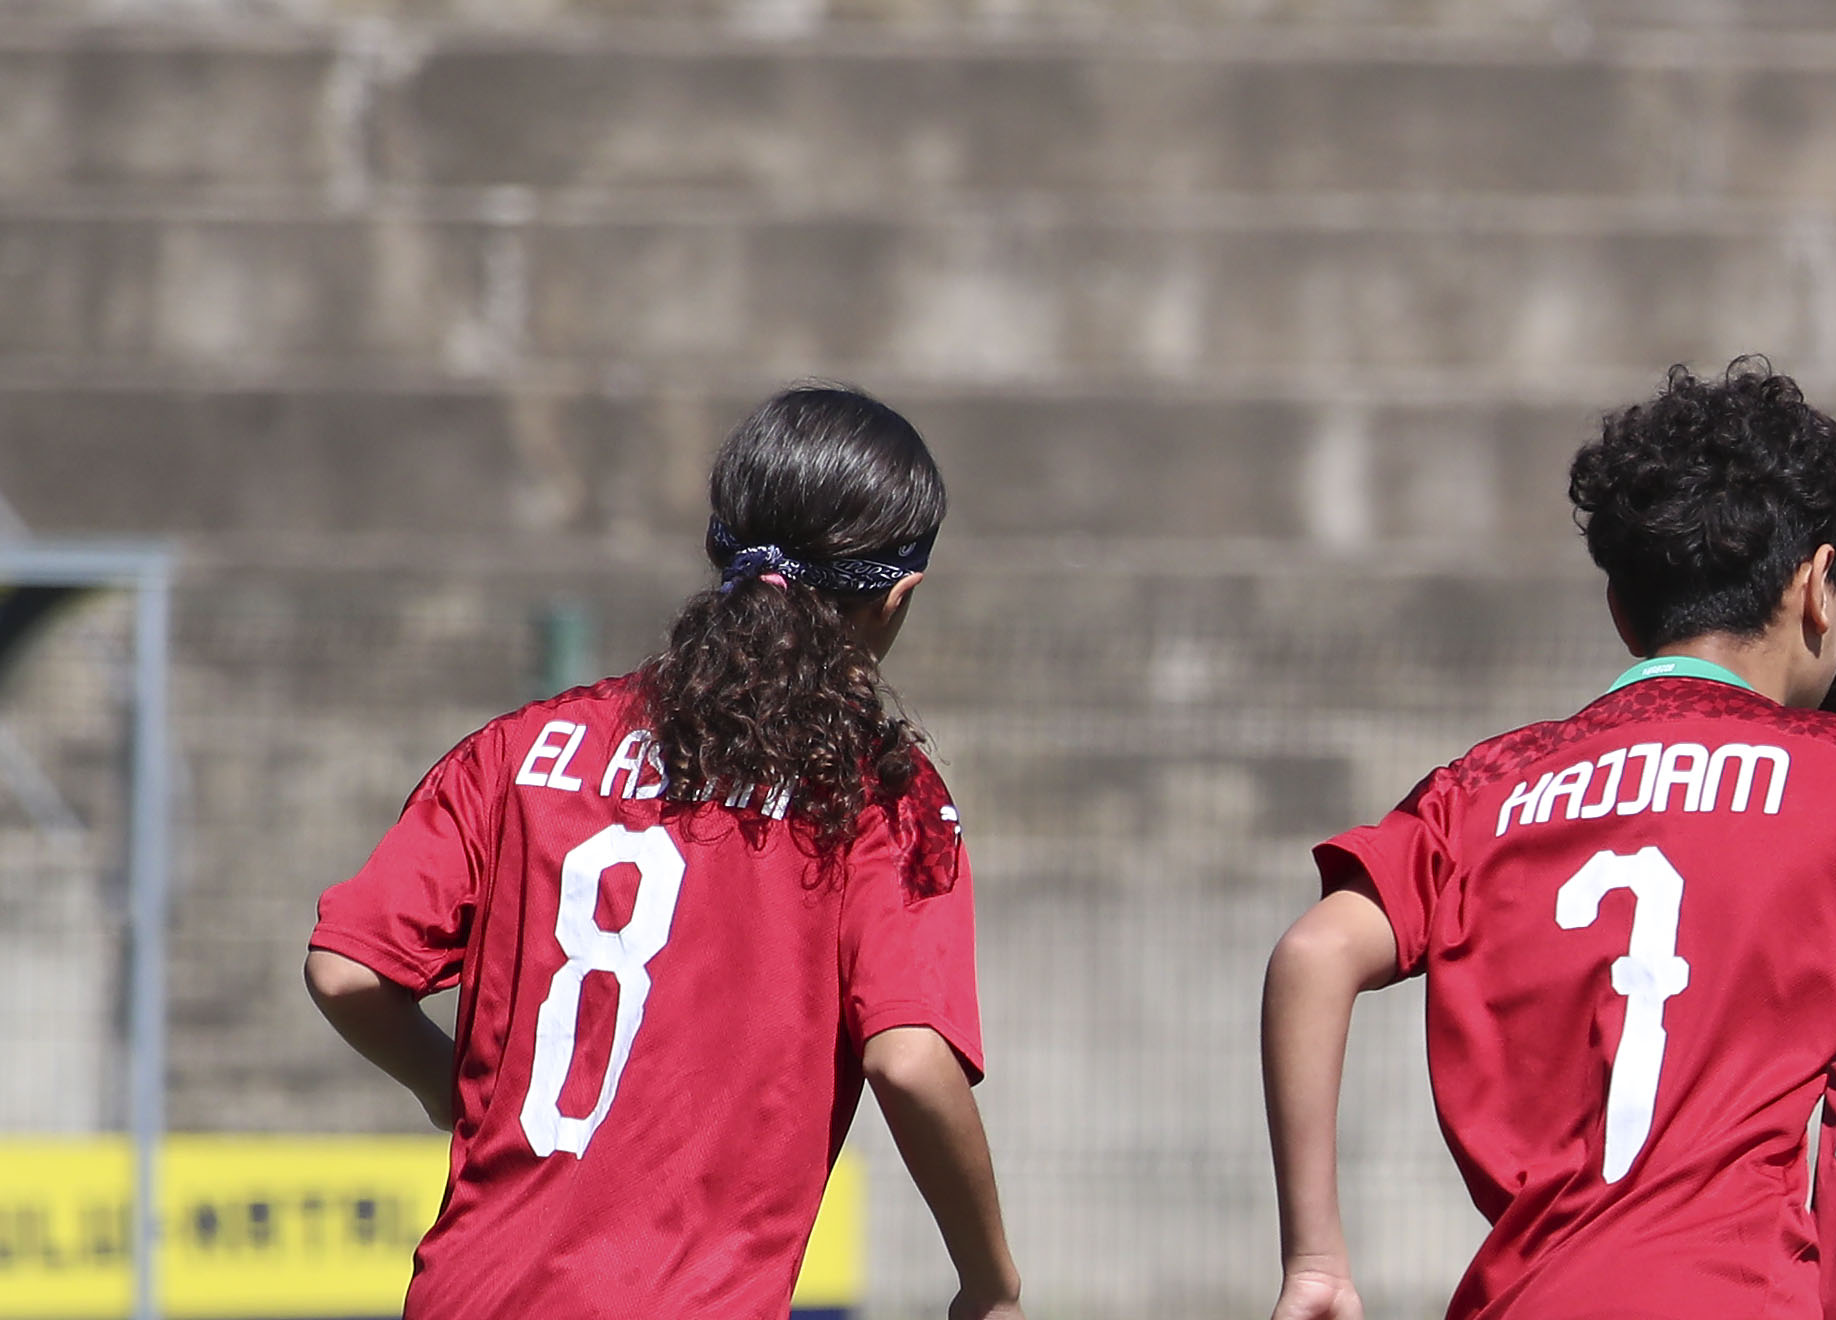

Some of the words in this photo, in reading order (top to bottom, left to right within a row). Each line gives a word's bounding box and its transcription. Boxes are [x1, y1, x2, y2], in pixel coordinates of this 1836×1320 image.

[514, 719, 587, 792] EL
[1495, 742, 1791, 838] HAJJAM
[519, 823, 687, 1159] 8
[1554, 845, 1690, 1184] 7
